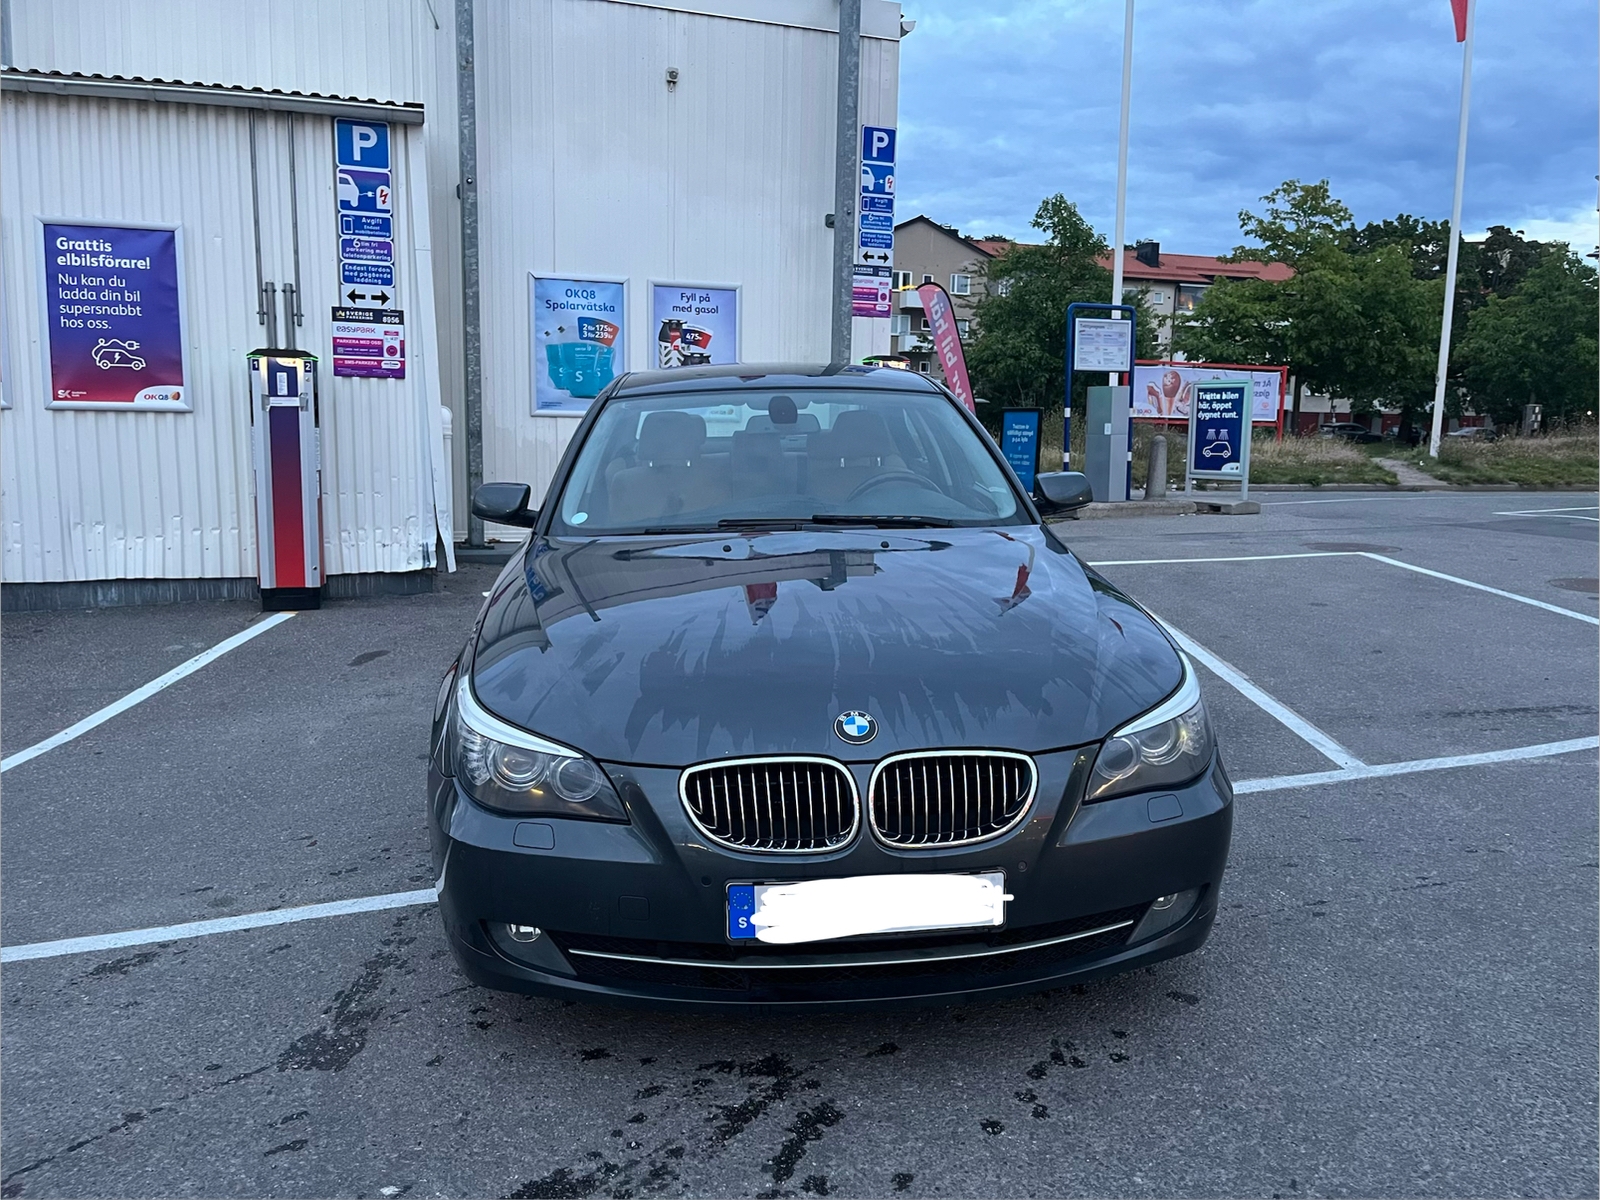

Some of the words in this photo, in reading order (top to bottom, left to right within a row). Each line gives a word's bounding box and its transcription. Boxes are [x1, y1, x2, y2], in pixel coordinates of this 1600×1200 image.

[352, 125, 378, 161] P
[872, 131, 889, 158] P
[56, 237, 112, 252] Grattis
[353, 238, 360, 248] 6
[57, 253, 150, 270] elbilsförare!
[58, 273, 77, 286] Nu
[81, 274, 105, 287] kan
[109, 275, 126, 287] du
[59, 288, 96, 300] ladda
[100, 290, 121, 301] din
[125, 290, 141, 302] bil
[565, 288, 596, 300] OKQ8
[680, 293, 696, 303] Fyll
[699, 293, 710, 303] på
[60, 304, 142, 317] supersnabbt
[546, 300, 615, 313] Spolarvätska
[672, 304, 692, 313] med
[695, 306, 718, 315] gasol
[61, 316, 84, 328] hos
[87, 319, 112, 329] oss.
[576, 371, 583, 382] S
[1212, 402, 1232, 410] öppet
[1198, 411, 1220, 420] dygnet
[839, 711, 873, 721] BMW
[738, 917, 748, 928] S
